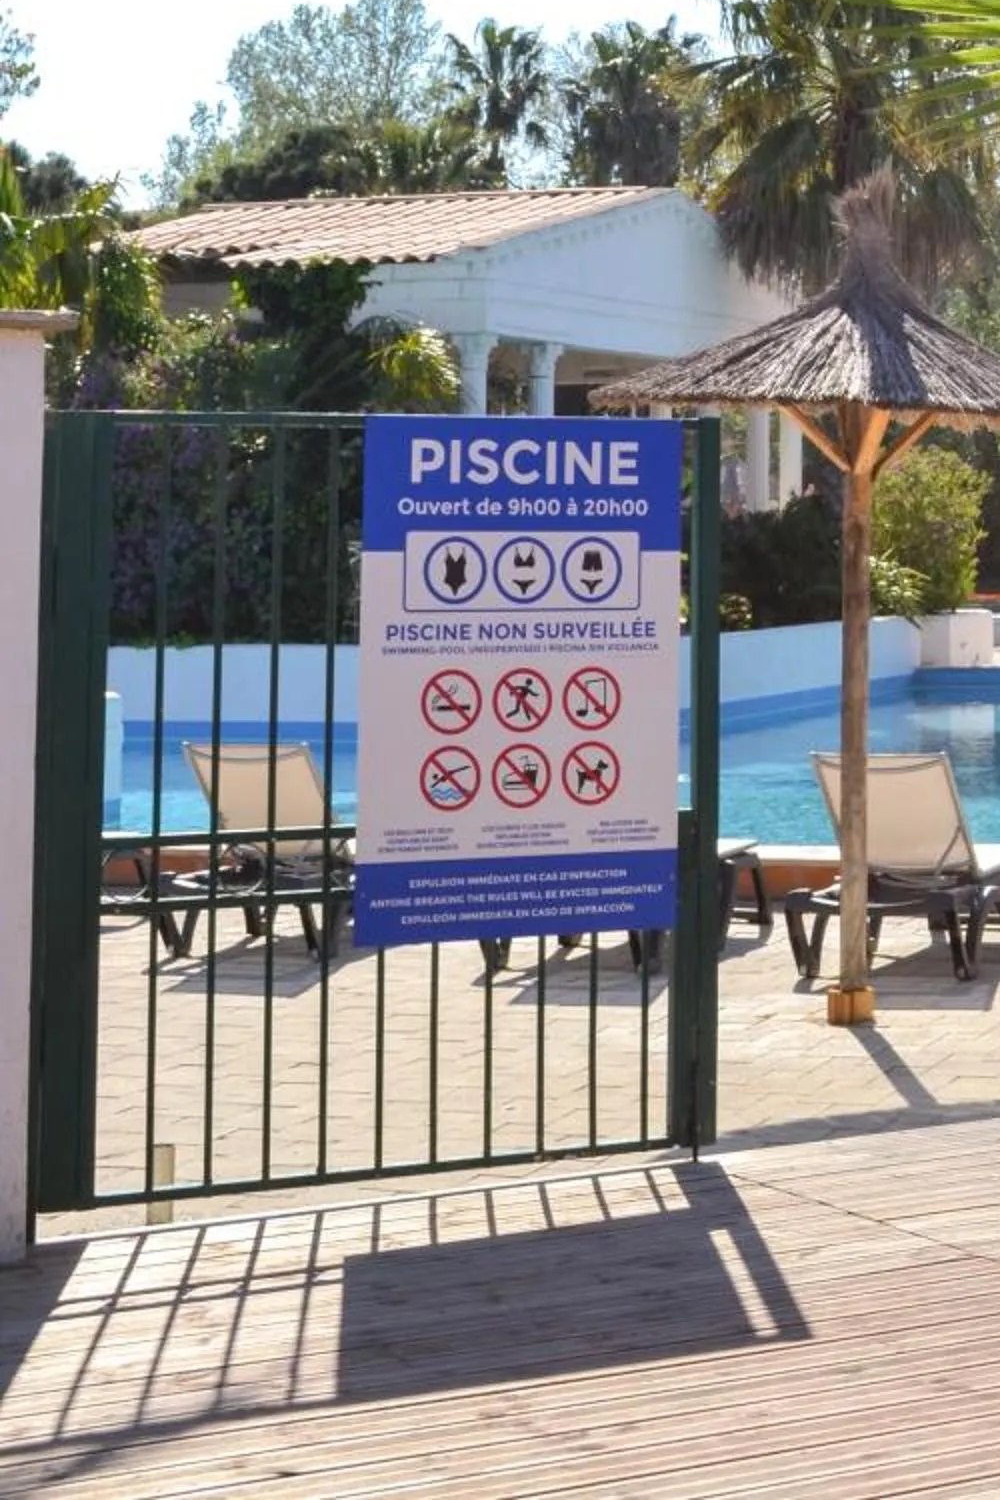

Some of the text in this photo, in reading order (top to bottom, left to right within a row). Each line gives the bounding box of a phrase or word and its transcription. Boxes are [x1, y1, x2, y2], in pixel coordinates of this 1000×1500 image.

[410, 438, 639, 485] PISCINE
[397, 497, 649, 517] Ouvert de 9h00 à 20h00
[386, 616, 657, 641] PISCINE NON SURVEILLÉE
